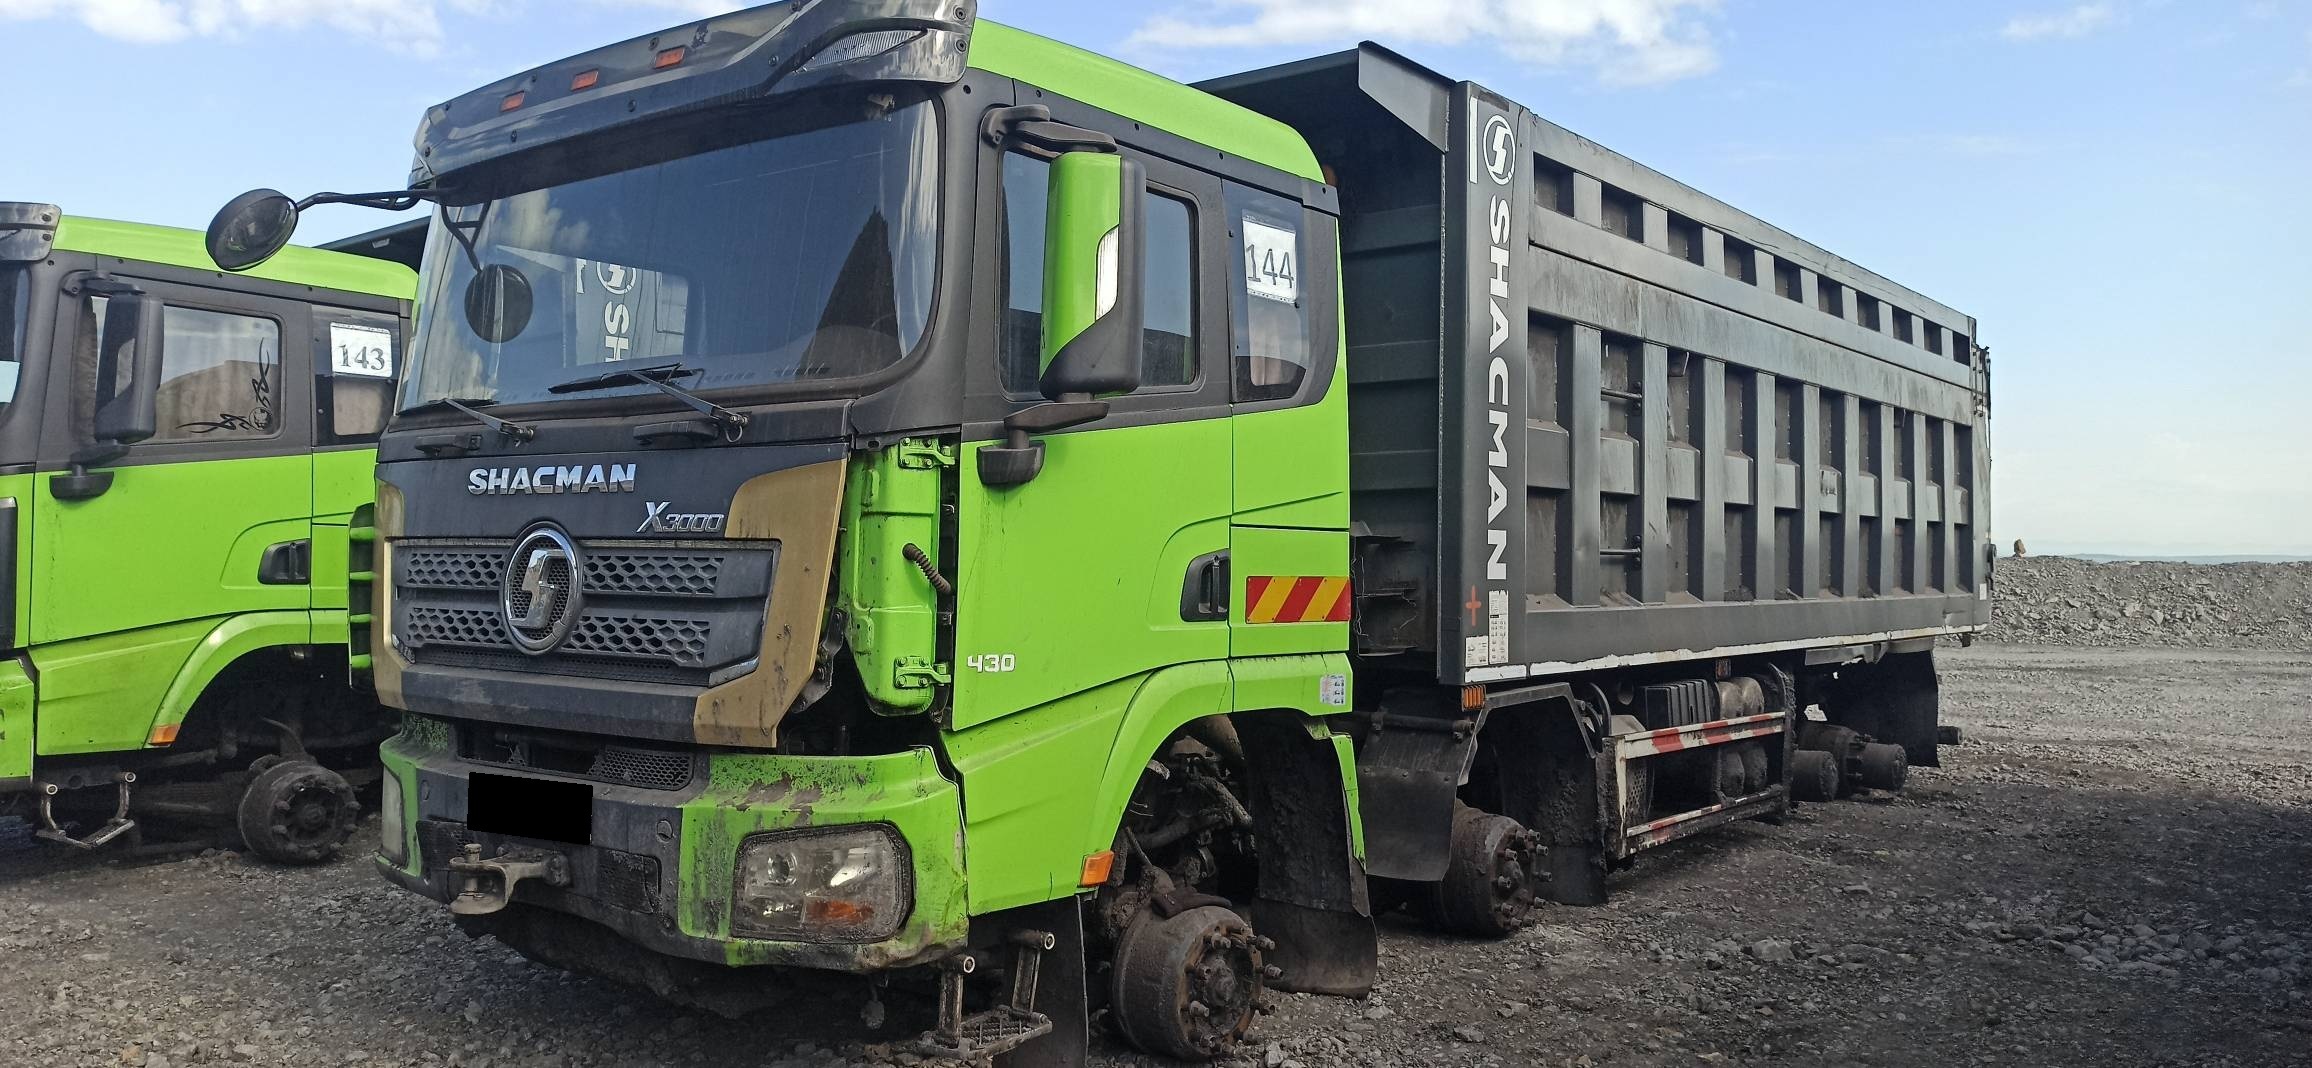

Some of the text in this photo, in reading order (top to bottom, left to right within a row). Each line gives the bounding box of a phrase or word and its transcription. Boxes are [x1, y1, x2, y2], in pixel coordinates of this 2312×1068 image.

[1246, 244, 1294, 288] 144
[337, 344, 385, 370] 143
[1487, 195, 1510, 580] SHACMAN
[468, 463, 637, 495] SHACMAN
[636, 501, 725, 533] X3000
[967, 654, 1015, 672] 430
